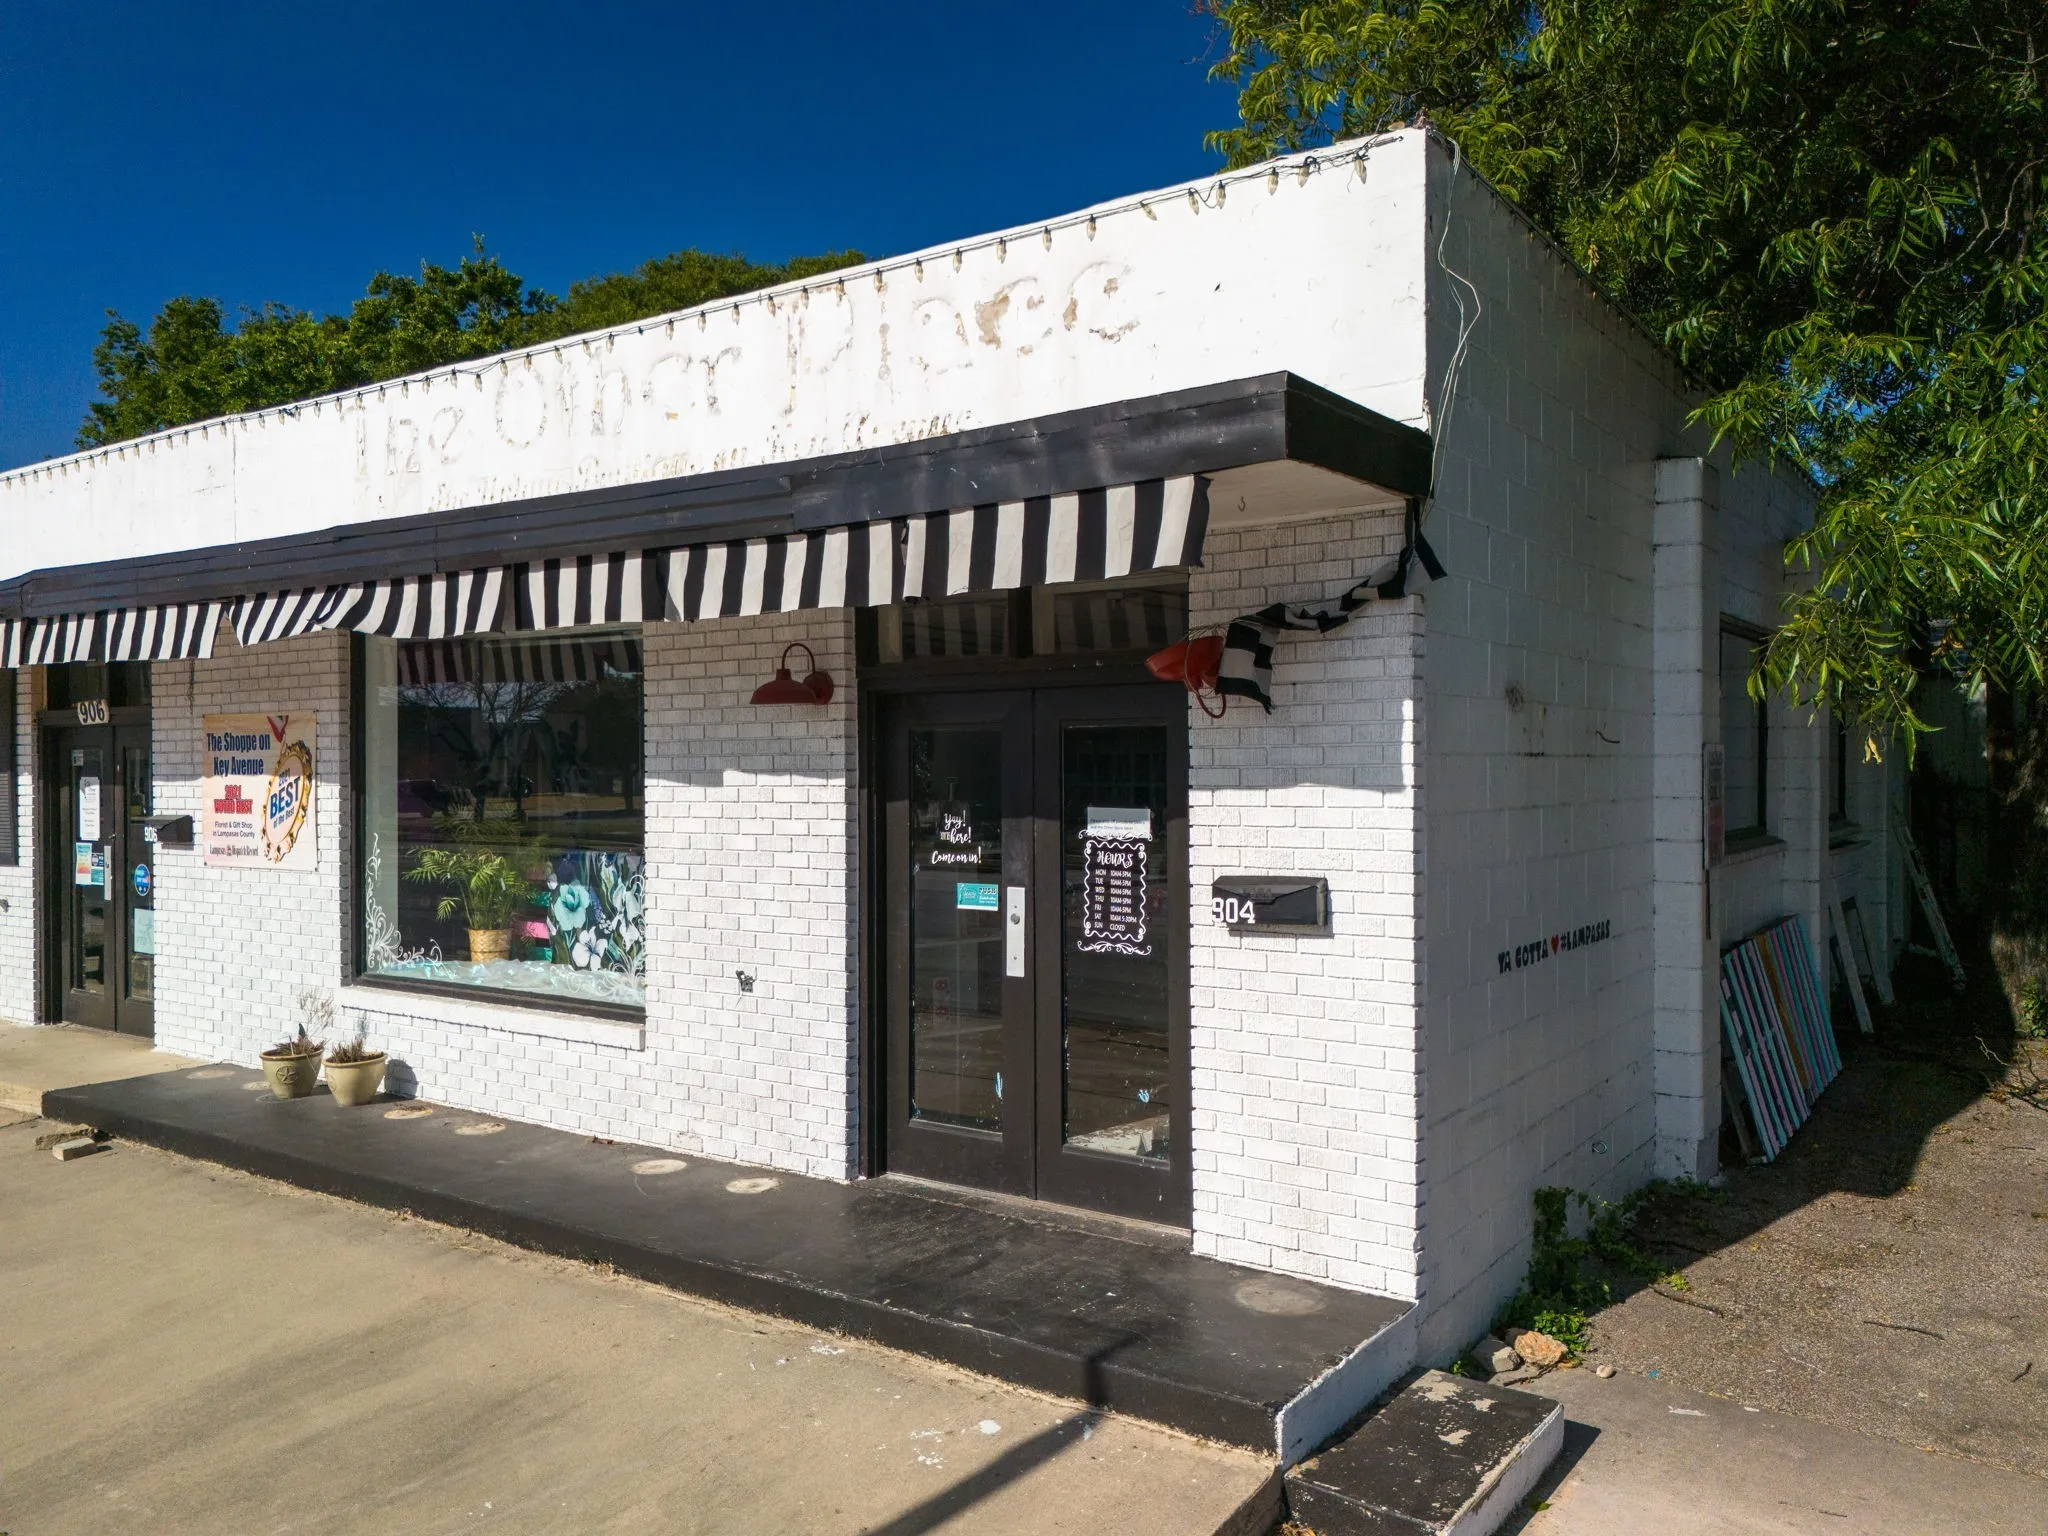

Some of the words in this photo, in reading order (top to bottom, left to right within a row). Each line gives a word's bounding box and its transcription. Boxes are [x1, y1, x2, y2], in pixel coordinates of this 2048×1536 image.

[79, 701, 106, 724] 906
[207, 733, 222, 751] The
[223, 732, 257, 752] Shoppe
[258, 733, 271, 751] on
[214, 757, 230, 777] Key
[231, 756, 264, 776] Avenue
[269, 777, 301, 819] BEST
[215, 821, 228, 829] Florist
[232, 821, 241, 829] Gift
[241, 822, 253, 830] Shop
[943, 809, 966, 830] Yay!
[240, 830, 256, 839] County
[950, 826, 972, 844] here!
[931, 851, 956, 865] Come
[956, 854, 968, 864] on
[967, 845, 982, 864] in!
[1096, 850, 1134, 869] HOURS
[1094, 886, 1105, 894] WED
[1095, 877, 1104, 885] TUE
[1094, 895, 1104, 903] THU
[1212, 897, 1256, 924] 904
[1109, 923, 1126, 932] CLOSED
[1497, 950, 1512, 974] YA
[1515, 938, 1549, 968] GOTTA
[1560, 919, 1611, 952] #LAMPASAS
